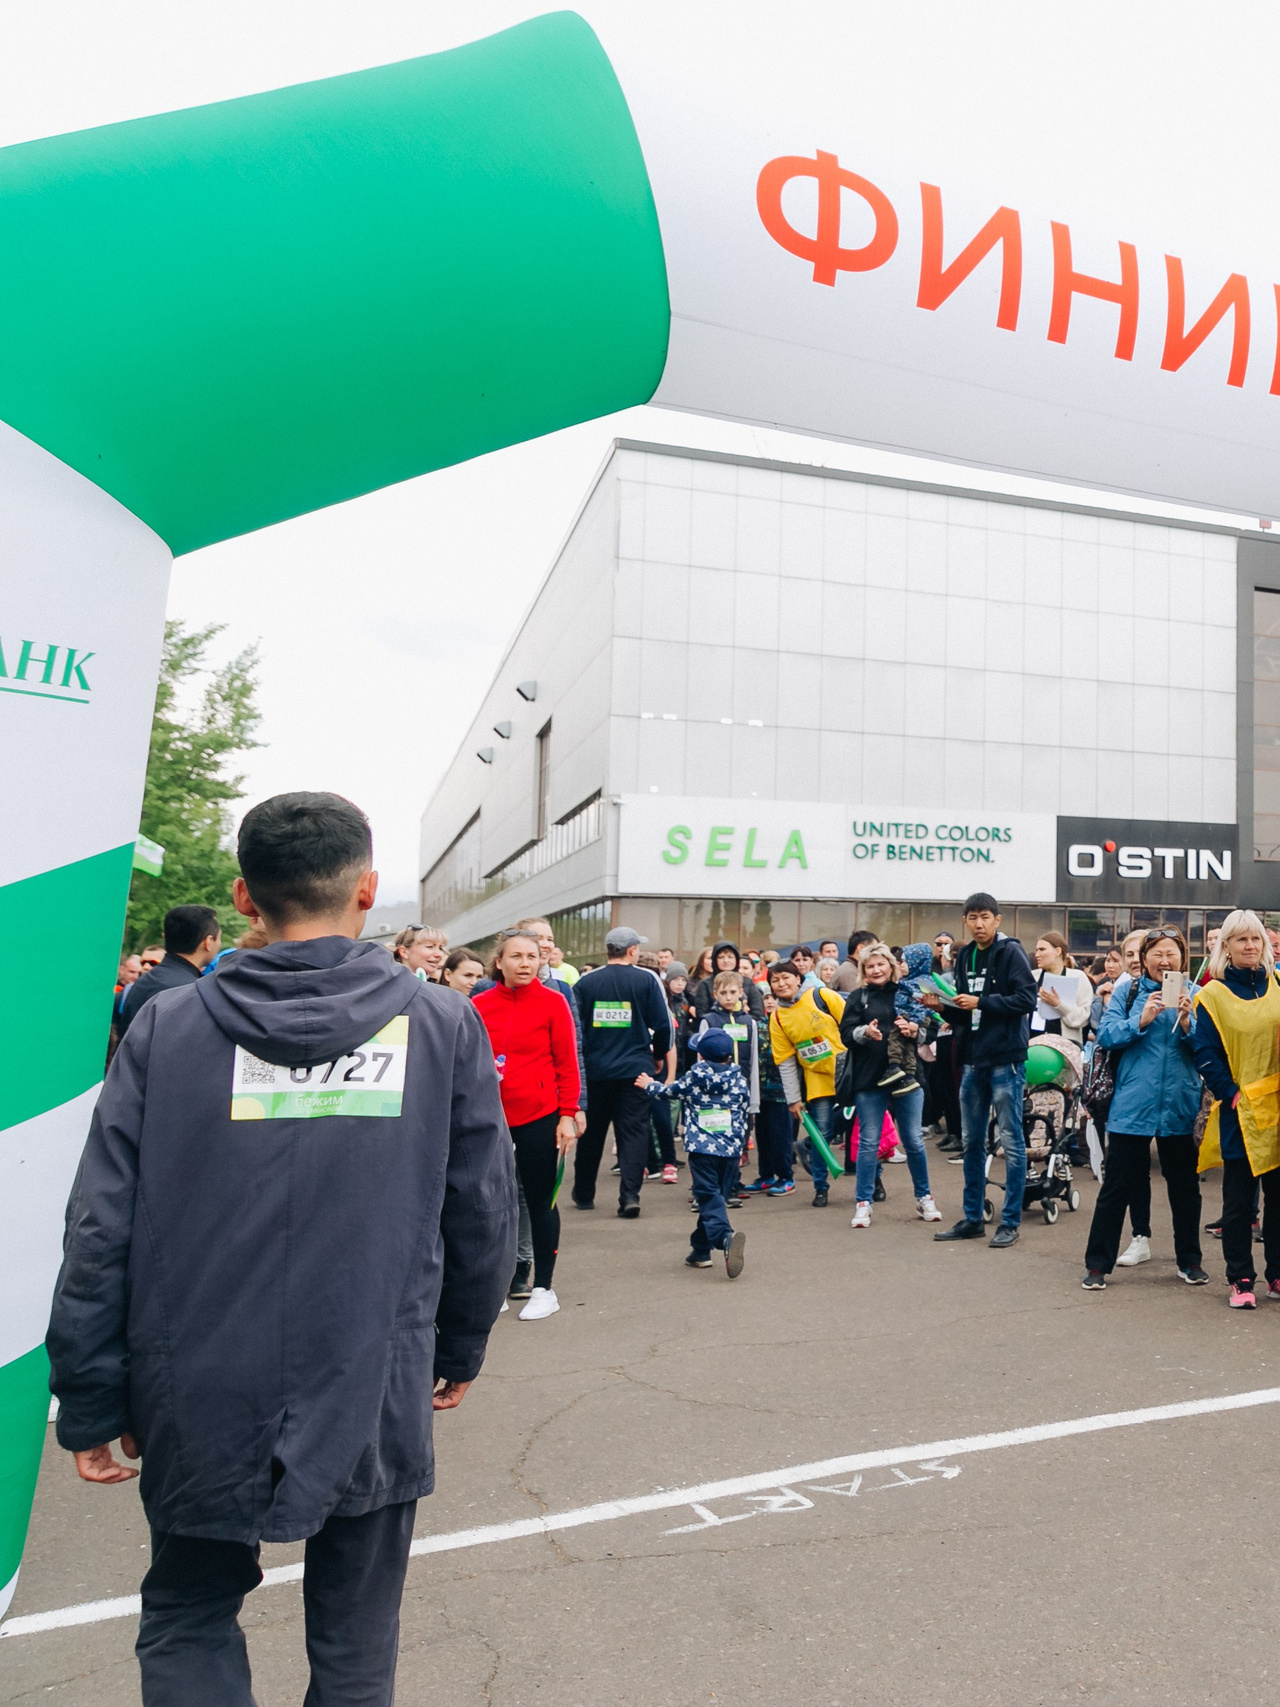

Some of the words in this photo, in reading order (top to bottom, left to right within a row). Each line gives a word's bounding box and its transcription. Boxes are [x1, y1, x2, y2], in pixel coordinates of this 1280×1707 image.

[853, 821, 928, 840] UNITED
[935, 824, 1012, 843] COLORS
[662, 825, 808, 869] SELA
[853, 843, 880, 860] OF
[606, 1011, 629, 1019] 0212
[807, 1042, 828, 1055] 0633
[295, 1094, 343, 1107] бежим
[660, 1459, 962, 1536] START
